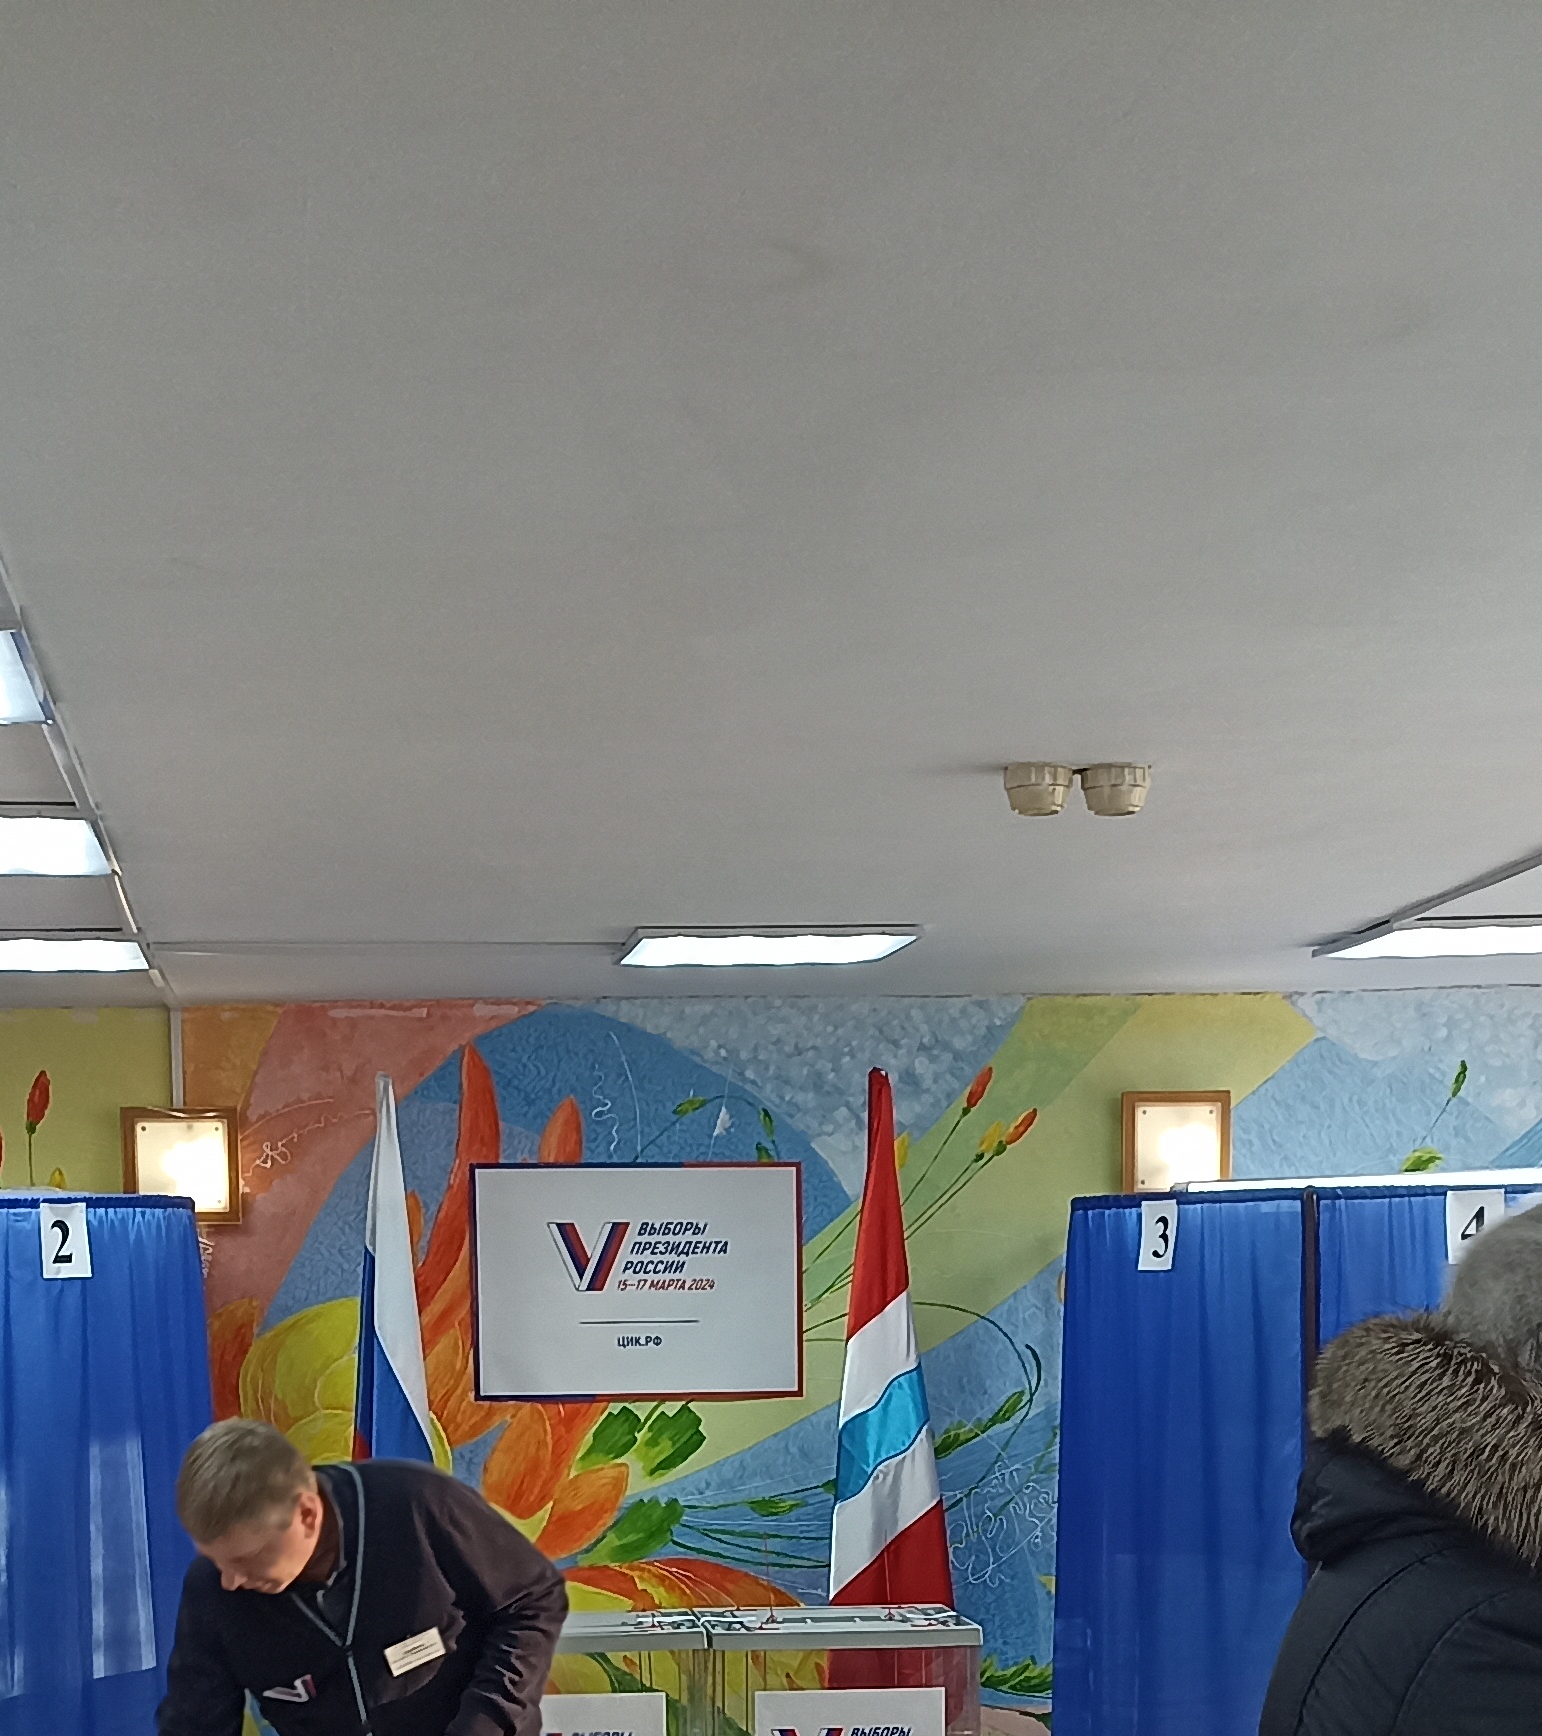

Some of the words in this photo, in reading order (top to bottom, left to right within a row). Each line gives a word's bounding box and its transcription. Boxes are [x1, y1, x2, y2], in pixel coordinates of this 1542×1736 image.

[637, 1221, 708, 1236] ВЫБОРЫ
[1460, 1205, 1485, 1243] 4
[50, 1220, 74, 1265] 2
[1151, 1215, 1170, 1259] 3
[630, 1240, 729, 1258] ПРЕЗИДЕНТА
[622, 1260, 686, 1275] РОССИИ
[648, 1279, 687, 1291] МАРТА
[687, 1278, 716, 1291] 2024
[617, 1336, 662, 1348] ЦИК.РФ
